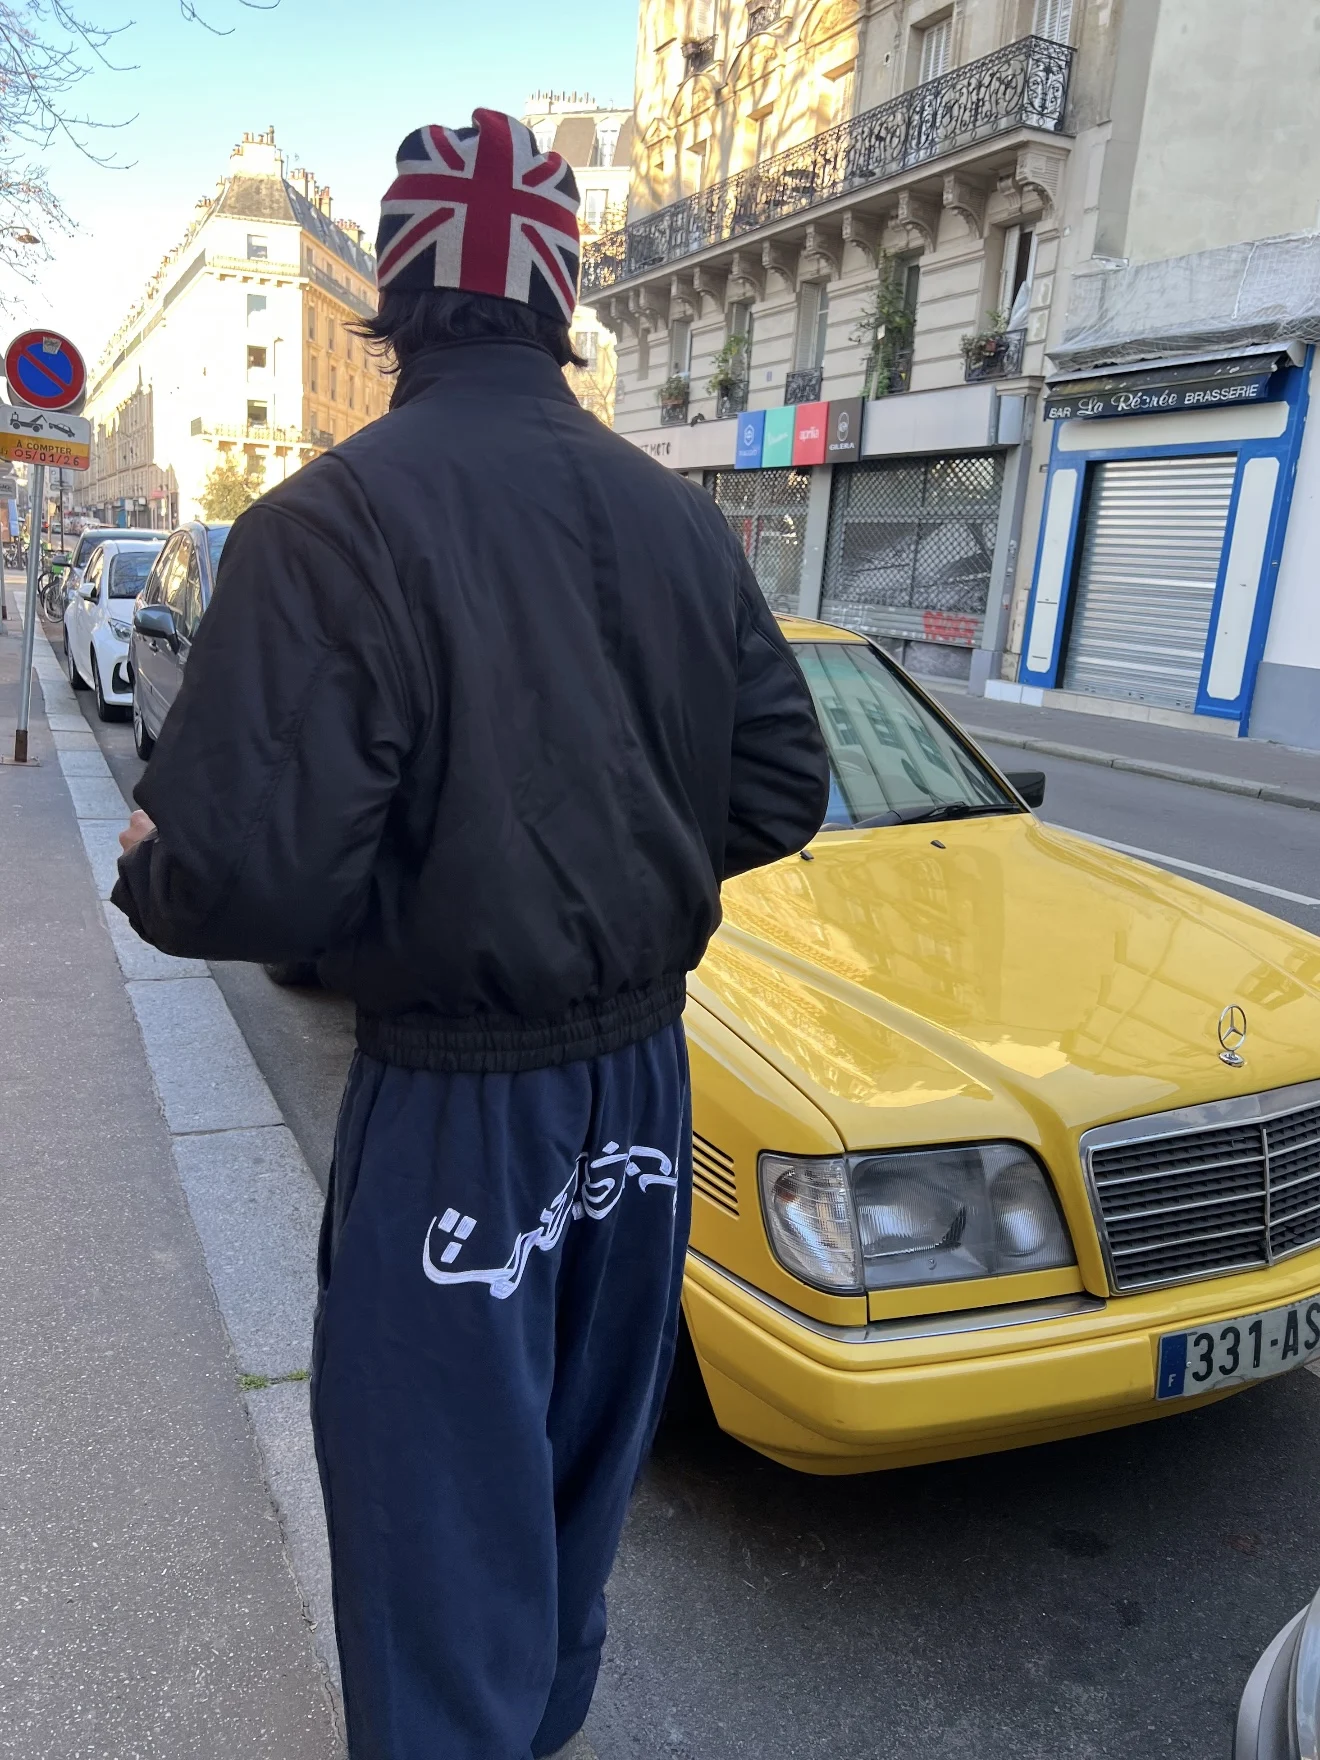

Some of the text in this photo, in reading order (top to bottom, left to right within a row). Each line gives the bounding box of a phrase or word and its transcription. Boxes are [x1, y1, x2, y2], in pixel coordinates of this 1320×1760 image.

[1048, 408, 1071, 419] BAR
[1077, 396, 1103, 416] La
[1184, 384, 1259, 404] BRASSERIE
[27, 442, 72, 455] COMPTER
[1168, 1373, 1177, 1388] F
